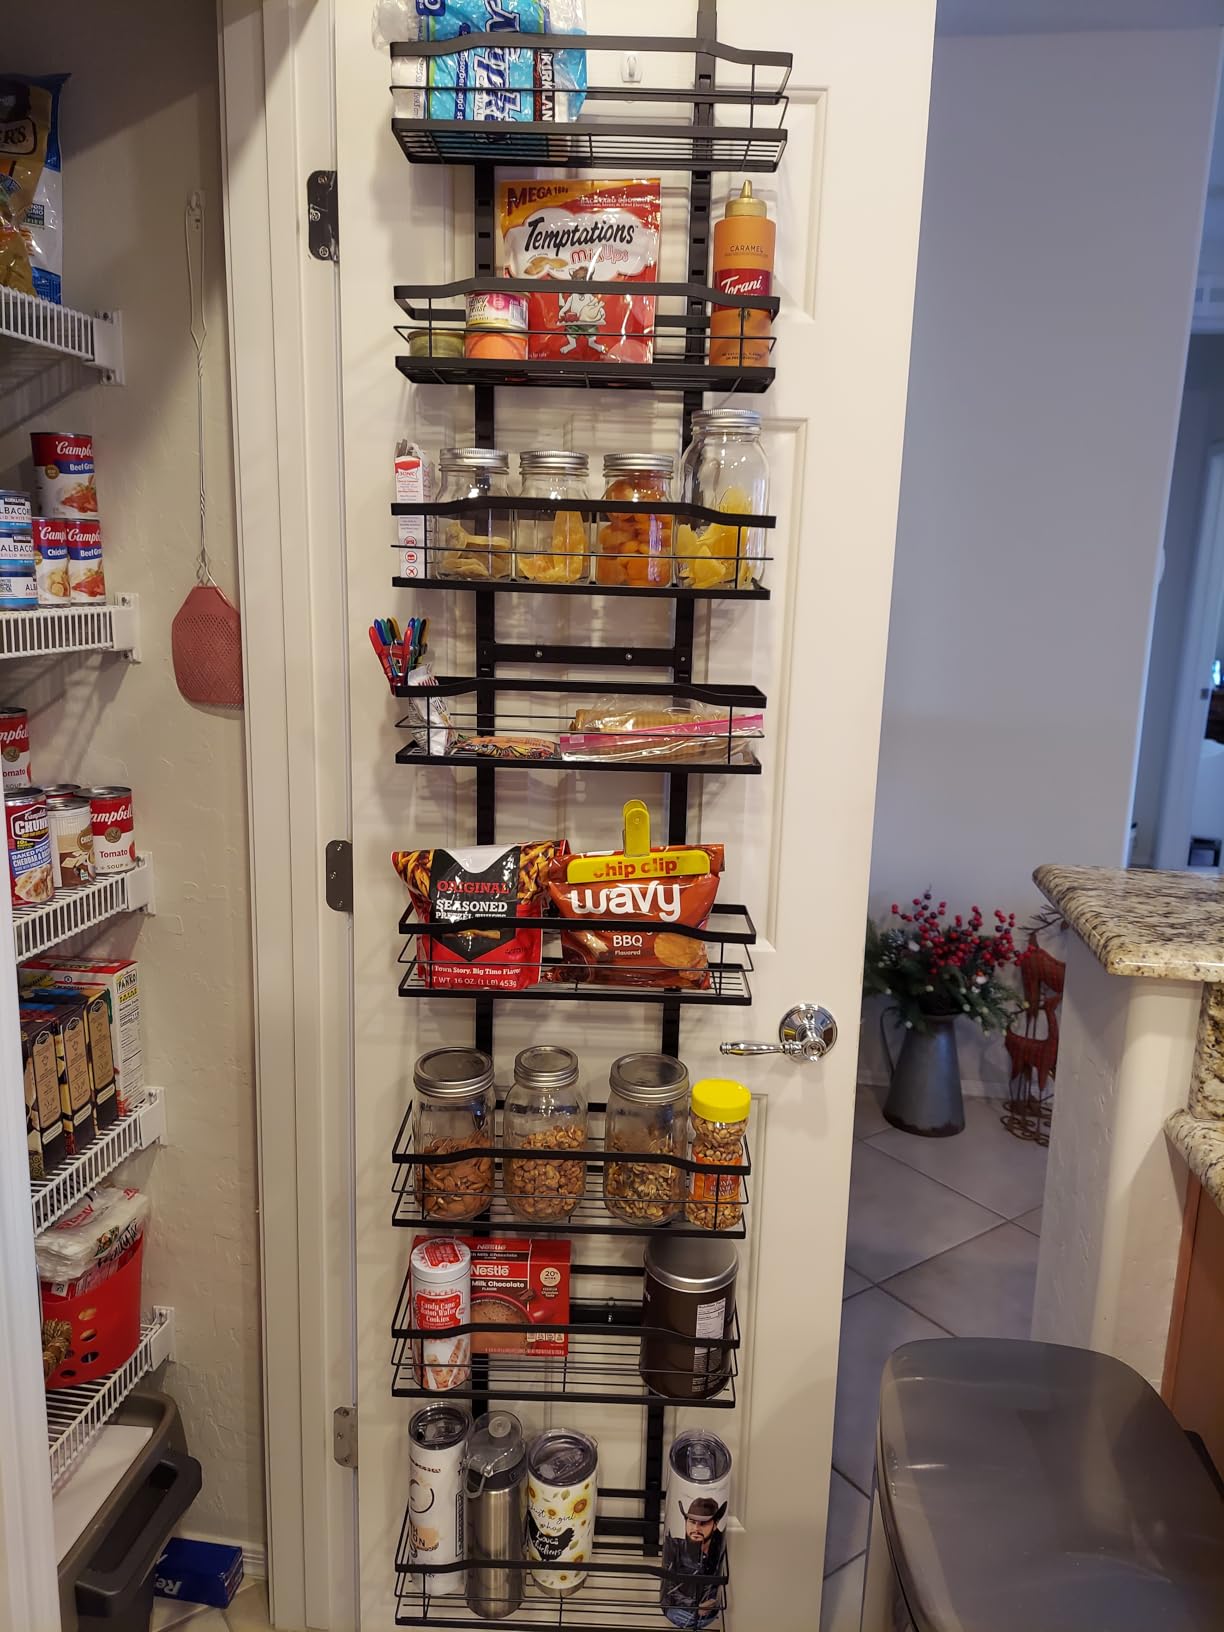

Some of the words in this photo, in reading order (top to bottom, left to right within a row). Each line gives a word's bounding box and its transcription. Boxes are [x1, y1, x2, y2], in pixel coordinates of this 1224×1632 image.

[541, 53, 554, 121] KIRKLAN
[507, 186, 552, 216] MEGA
[524, 217, 635, 256] Temptations
[729, 245, 764, 253] CARAMEL
[720, 276, 762, 295] Torani
[1, 544, 32, 553] ALBACO
[3, 769, 26, 777] omato
[99, 849, 128, 858] Tomato
[641, 856, 678, 874] clip
[437, 880, 509, 894] ORIGINAL
[436, 899, 508, 912] SEASONED
[571, 880, 681, 922] wavy
[613, 934, 643, 947] BBQ
[472, 967, 484, 975] Big
[500, 979, 517, 987] 453g
